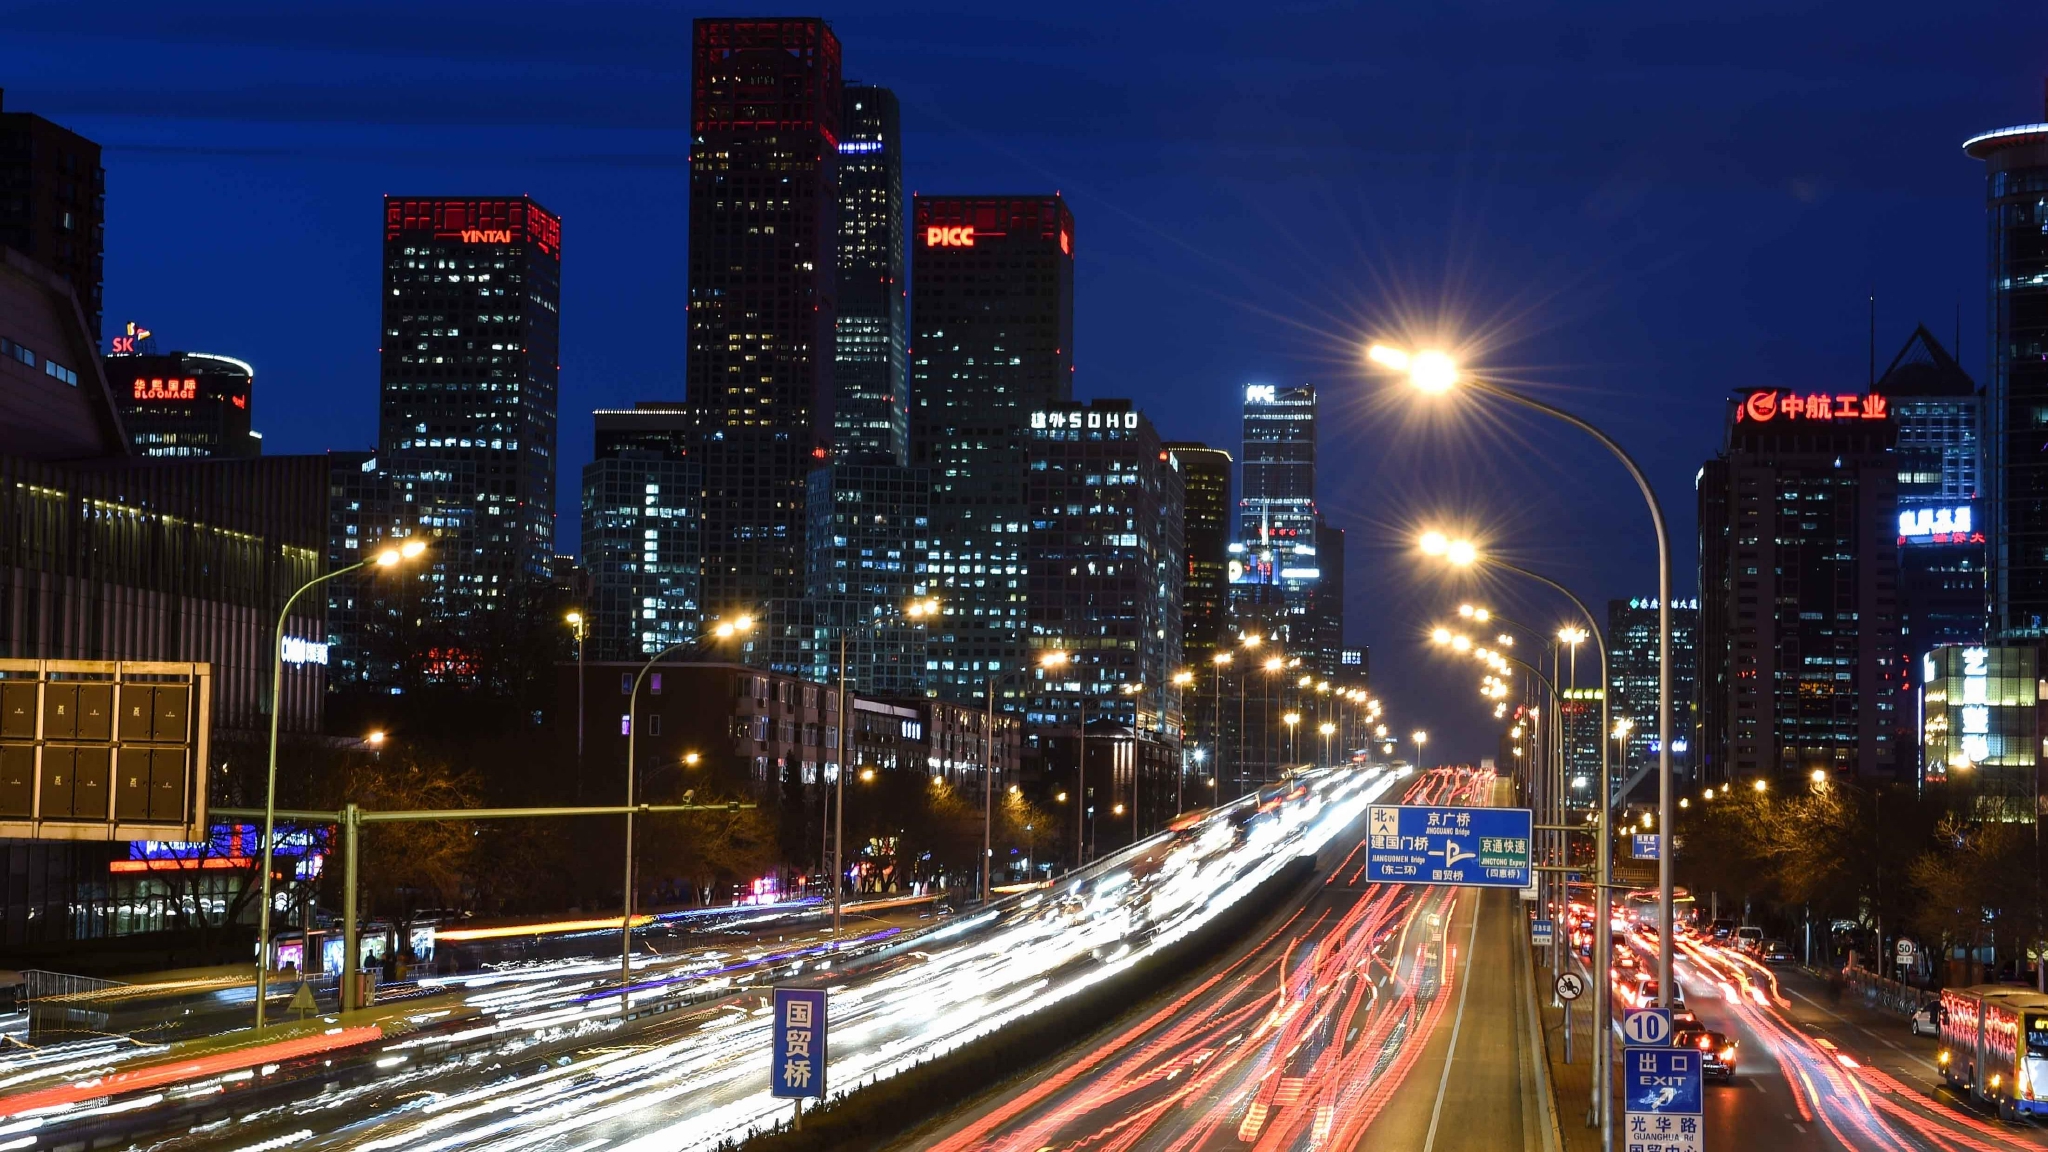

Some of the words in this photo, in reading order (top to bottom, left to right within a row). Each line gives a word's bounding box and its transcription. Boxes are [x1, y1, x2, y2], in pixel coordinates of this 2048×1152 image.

[461, 229, 511, 243] YINTAI
[927, 226, 974, 247] PICC
[112, 337, 134, 352] SK
[134, 378, 197, 391] 华熙国际
[134, 389, 195, 399] BLOOMAGE
[1781, 394, 1887, 419] 中航工业
[1031, 411, 1138, 429] 建外SOHO
[1374, 808, 1387, 823] 北
[1388, 815, 1395, 823] N
[1427, 812, 1471, 827] 京广桥
[1426, 827, 1453, 836] JINGGUANG
[1454, 828, 1471, 837] Bridge
[1371, 835, 1429, 852] 建国门桥
[1482, 838, 1526, 855] 京通快速
[1372, 855, 1409, 864] JIANGUOMEN
[1410, 855, 1426, 865] Bridge
[1481, 857, 1508, 866] JINGTONG
[1509, 858, 1526, 868] Expwy
[1381, 865, 1417, 876] (东二环)
[1432, 869, 1464, 882] 国贸桥
[1485, 868, 1521, 879] (四惠桥)
[1898, 943, 1911, 953] 50
[1633, 1015, 1659, 1040] 10
[783, 1000, 812, 1088] 国贸桥
[1639, 1053, 1688, 1073] 出口
[1640, 1075, 1687, 1087] EXIT
[1631, 1116, 1697, 1134] 光华路
[1633, 1132, 1680, 1142] GUANGHUA
[1683, 1132, 1694, 1142] Rd
